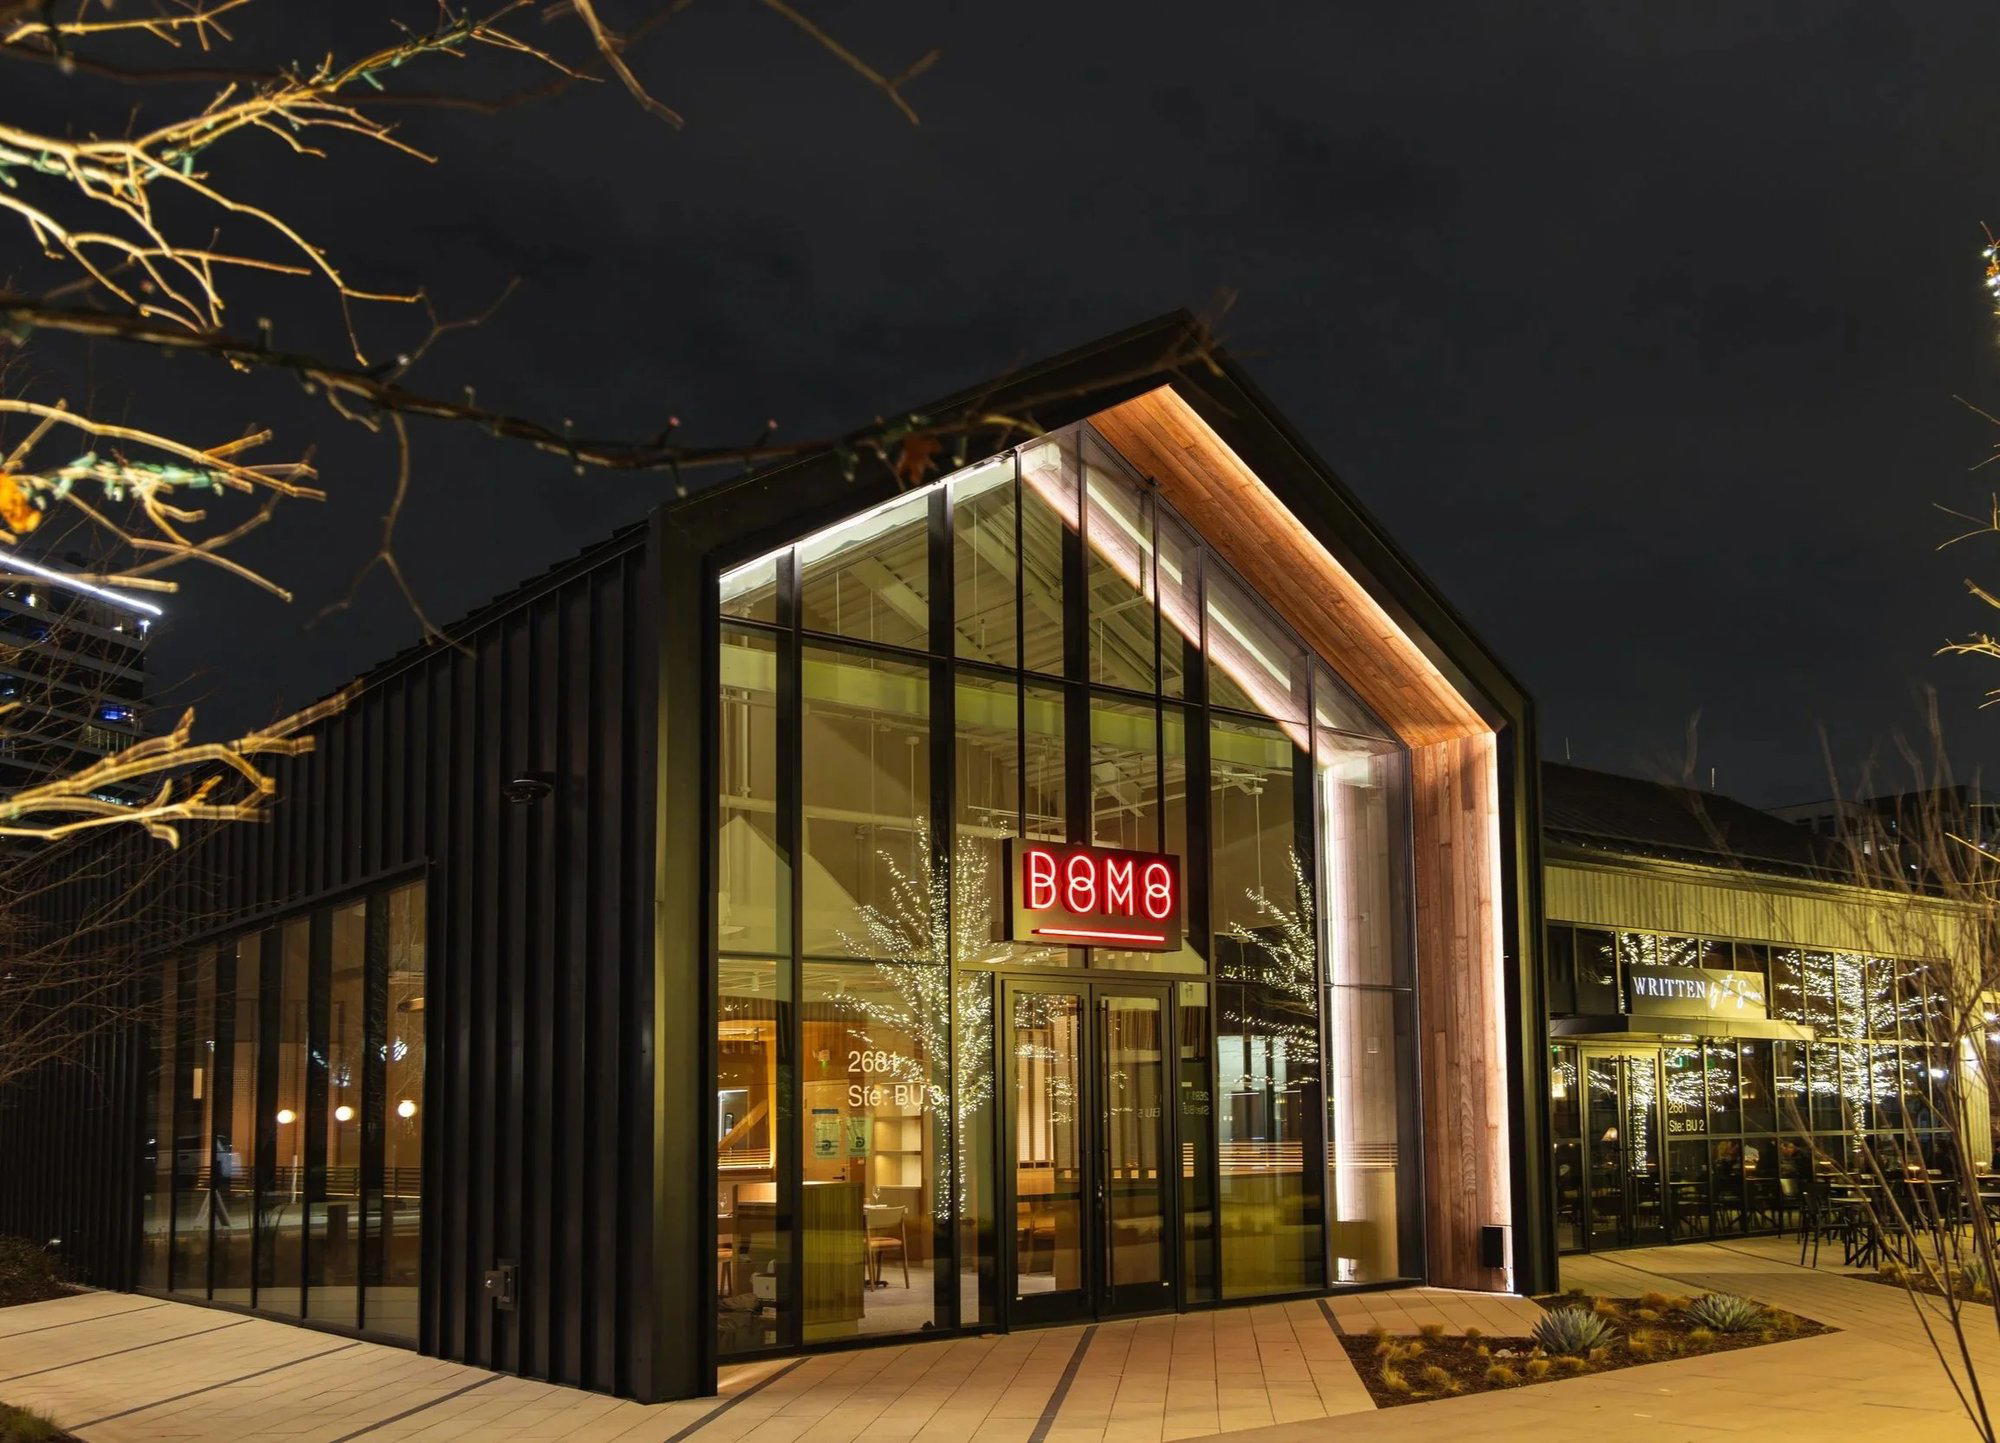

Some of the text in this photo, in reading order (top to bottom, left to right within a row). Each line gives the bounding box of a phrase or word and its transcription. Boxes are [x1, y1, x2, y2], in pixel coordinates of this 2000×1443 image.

[1633, 976, 1706, 999] WRITTEN
[848, 1050, 899, 1073] 2681
[848, 1084, 889, 1107] Ste:
[895, 1084, 925, 1106] BU
[1669, 1101, 1687, 1114] 2681
[1669, 1119, 1705, 1132] Ste: BU 2
